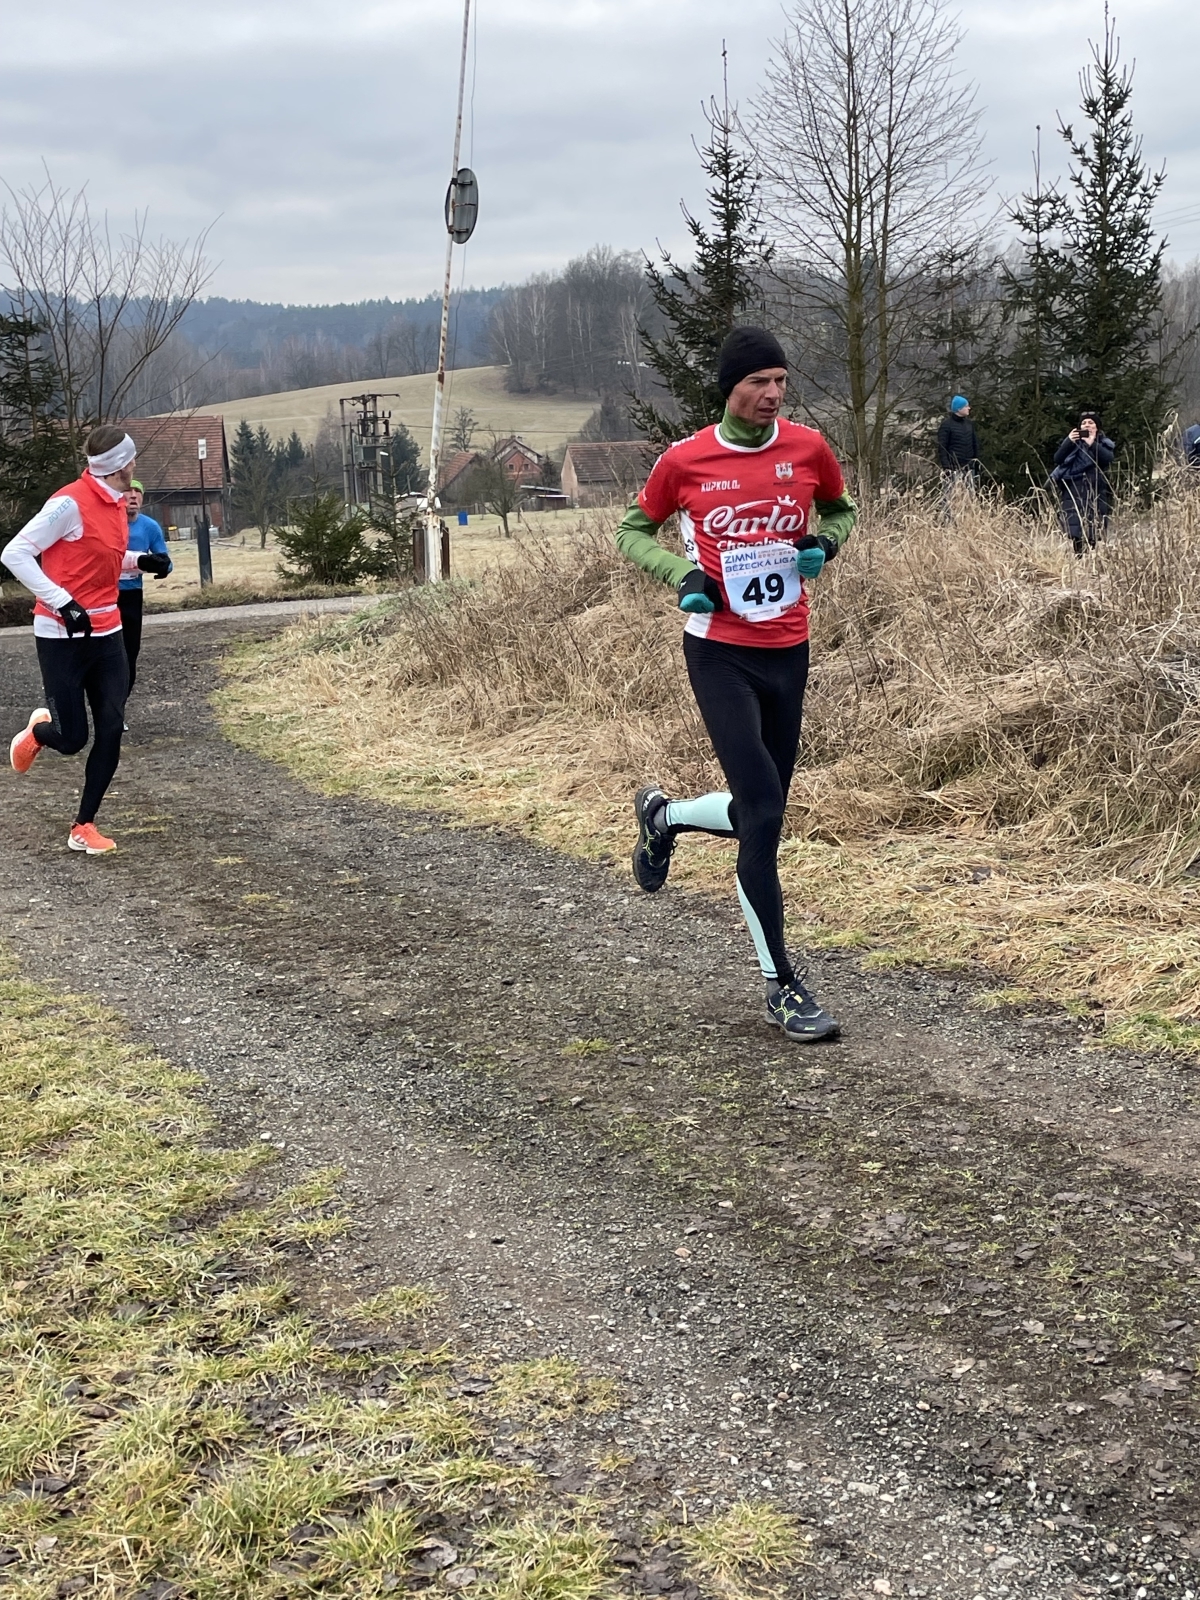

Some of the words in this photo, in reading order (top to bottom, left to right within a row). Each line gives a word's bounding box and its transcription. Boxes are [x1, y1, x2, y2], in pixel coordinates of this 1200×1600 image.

[703, 503, 803, 538] Carla
[724, 550, 757, 564] ZIMNÍ
[774, 556, 796, 565] LIGA
[742, 573, 785, 606] 49
